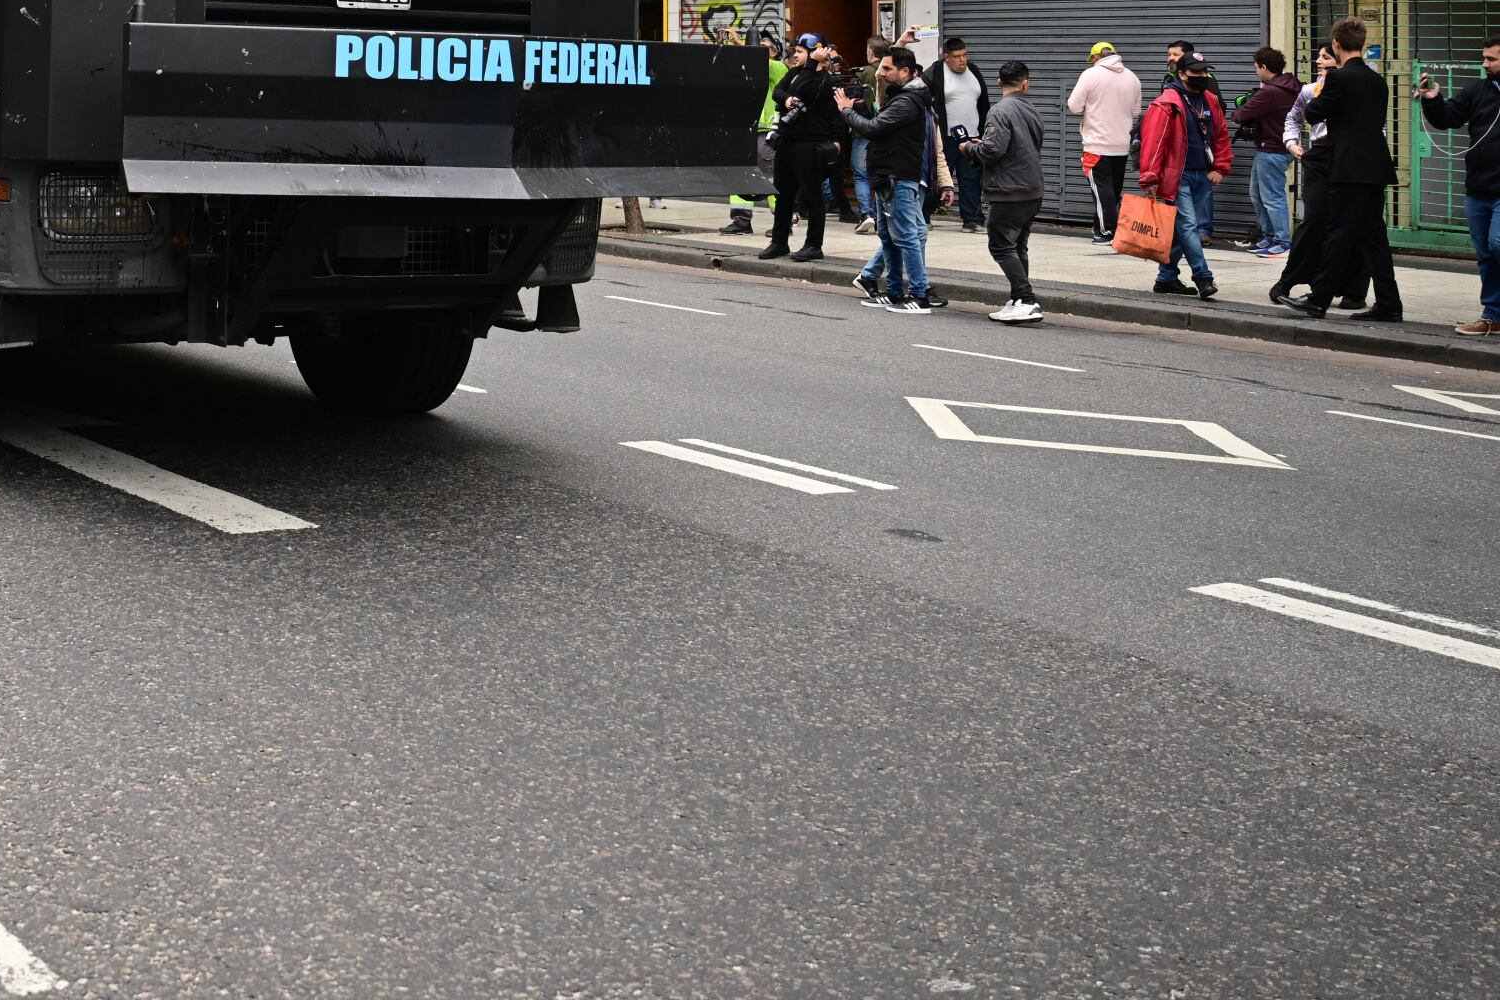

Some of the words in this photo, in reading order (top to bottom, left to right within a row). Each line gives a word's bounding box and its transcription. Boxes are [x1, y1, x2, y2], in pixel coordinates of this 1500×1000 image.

[334, 34, 515, 82] POLICIA
[523, 40, 651, 85] FEDERAL
[1131, 220, 1160, 239] DIMPLE
